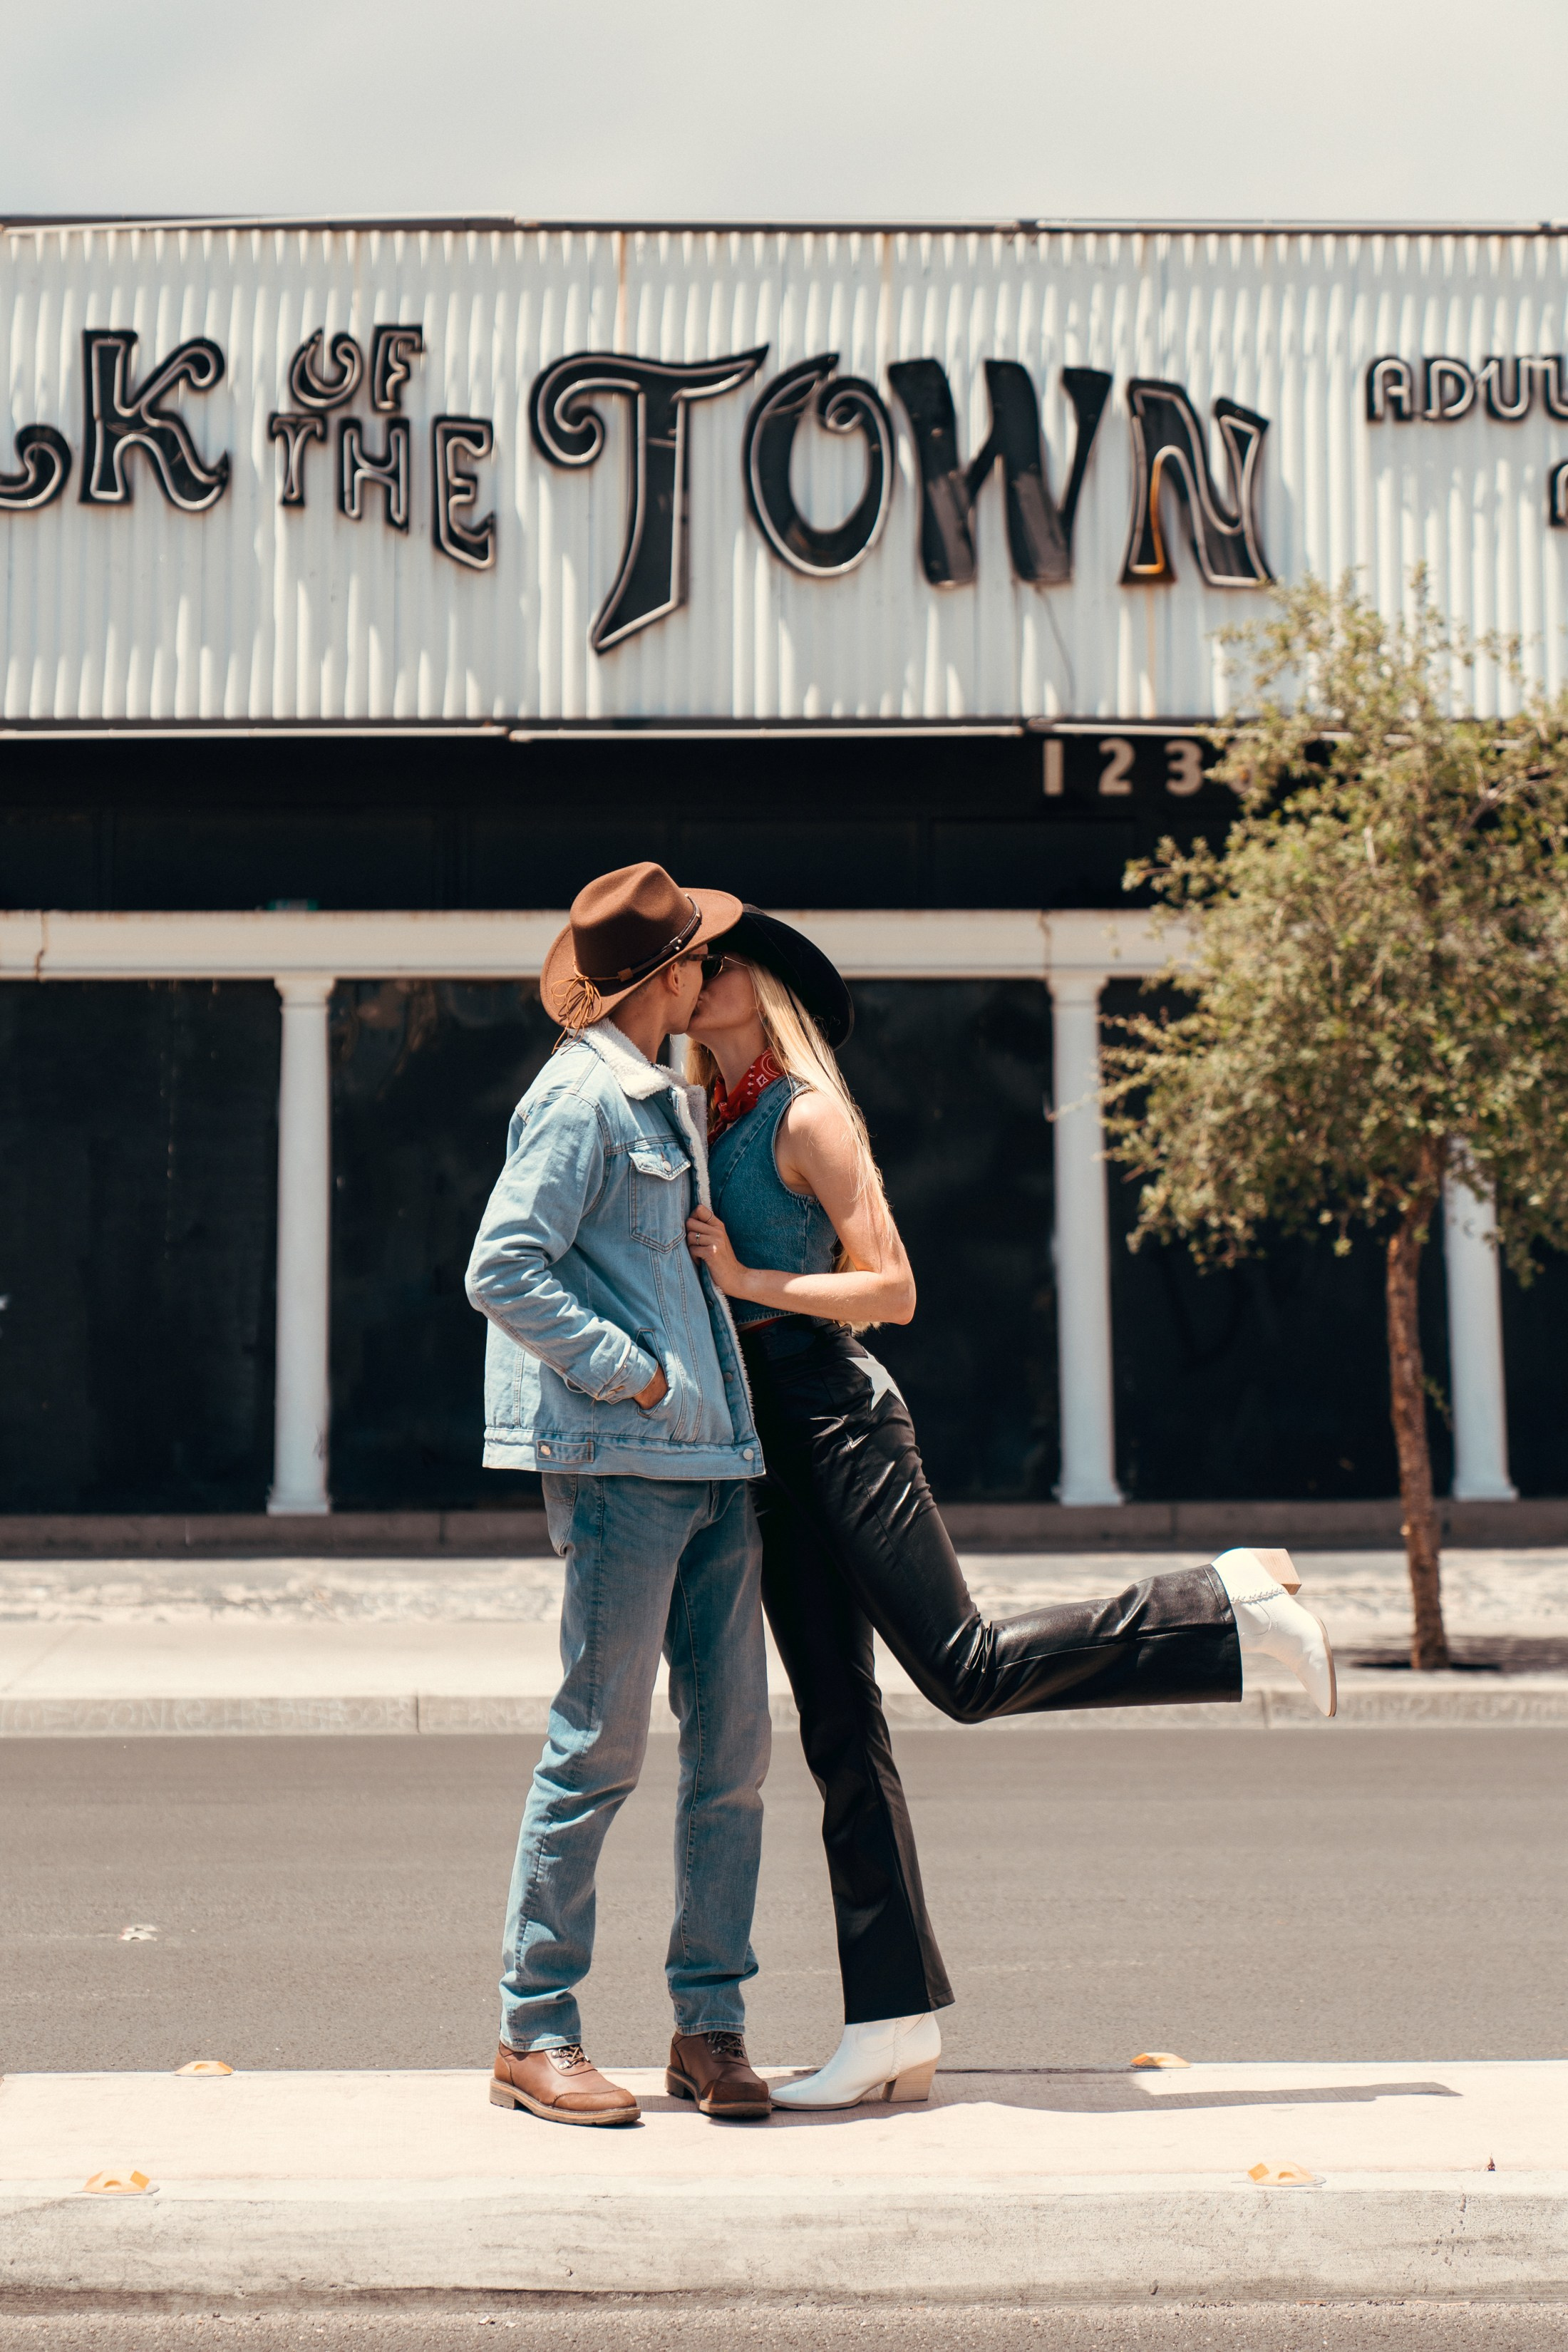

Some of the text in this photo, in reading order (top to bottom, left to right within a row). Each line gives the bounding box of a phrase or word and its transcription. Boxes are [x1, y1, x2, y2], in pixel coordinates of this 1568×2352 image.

[0, 324, 1277, 655] K OF THE TOWN
